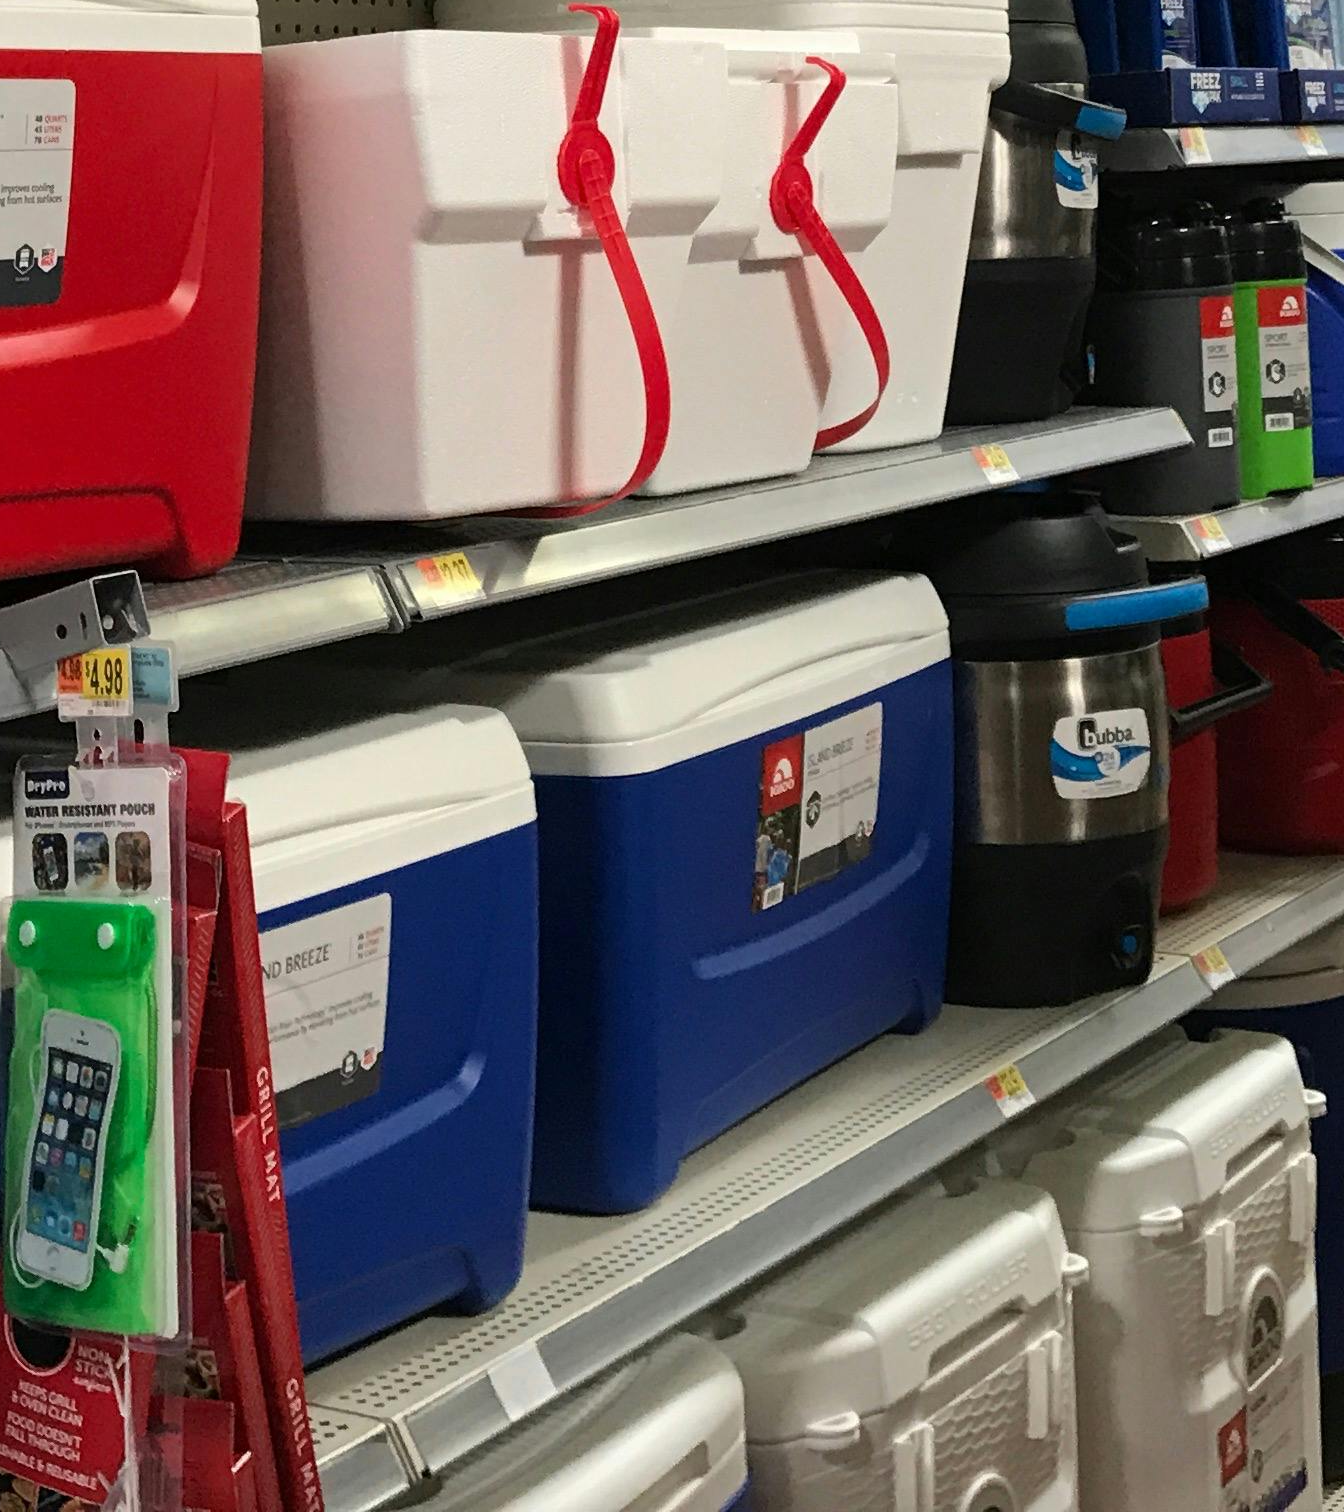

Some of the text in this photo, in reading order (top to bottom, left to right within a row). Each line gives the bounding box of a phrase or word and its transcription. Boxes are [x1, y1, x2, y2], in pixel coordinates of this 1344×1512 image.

[1190, 72, 1222, 90] FREEZ
[7, 195, 24, 205] from
[24, 194, 36, 204] hot
[37, 194, 63, 204] surfaces
[31, 183, 55, 194] cooling
[85, 657, 123, 696] $4.98
[1084, 726, 1134, 747] bubba
[27, 779, 66, 795] DryPro
[25, 803, 156, 818] WATER RESISTANT POUCH
[285, 944, 330, 976] BREEZE
[256, 1066, 274, 1145] GRILL
[264, 1149, 281, 1203] MAT
[285, 1377, 308, 1458] GRILL
[300, 1461, 325, 1512] MAT
